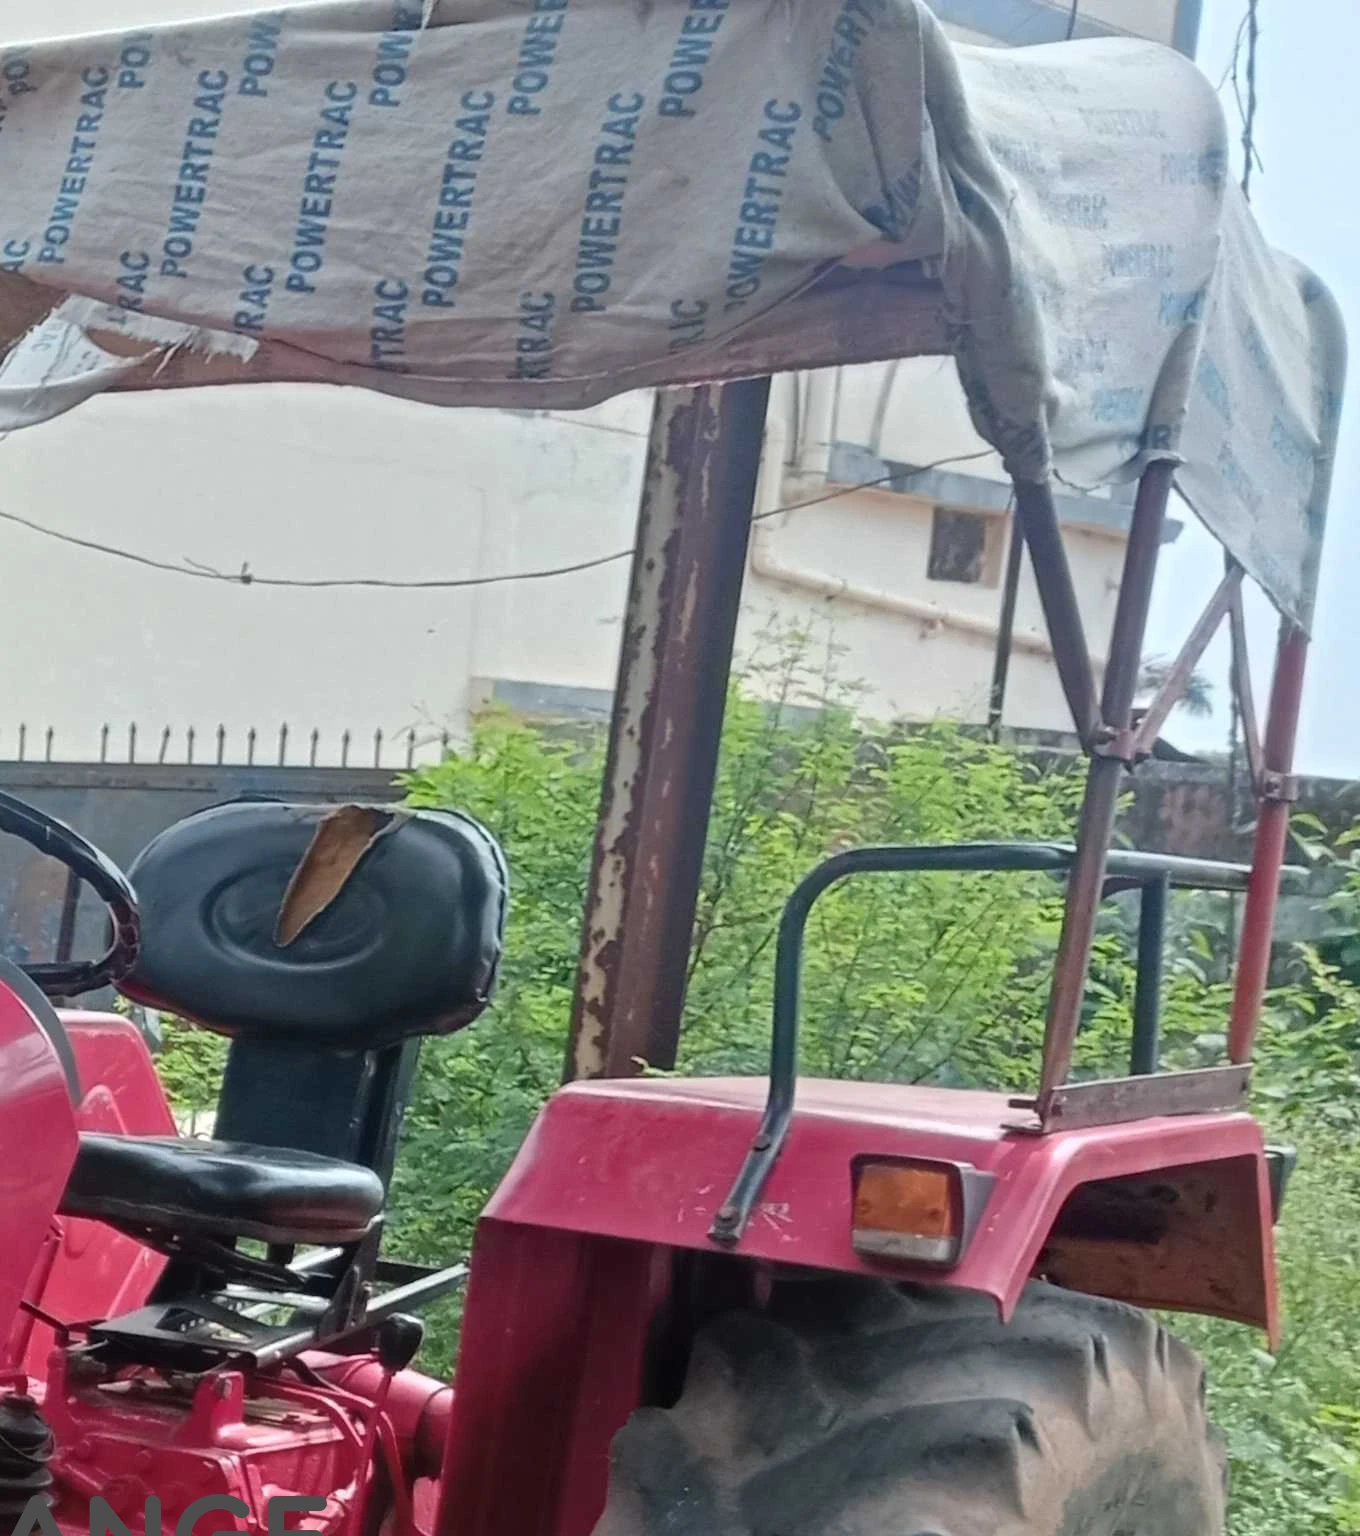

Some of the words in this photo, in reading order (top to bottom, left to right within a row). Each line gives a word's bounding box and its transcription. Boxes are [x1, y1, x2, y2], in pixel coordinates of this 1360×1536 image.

[36, 64, 110, 264] POWERTRAC
[160, 69, 229, 279] POWERTRAC
[284, 80, 358, 294] POWERTRAC
[421, 90, 495, 309] POWERTRAC
[570, 92, 645, 313] POWERTRAC
